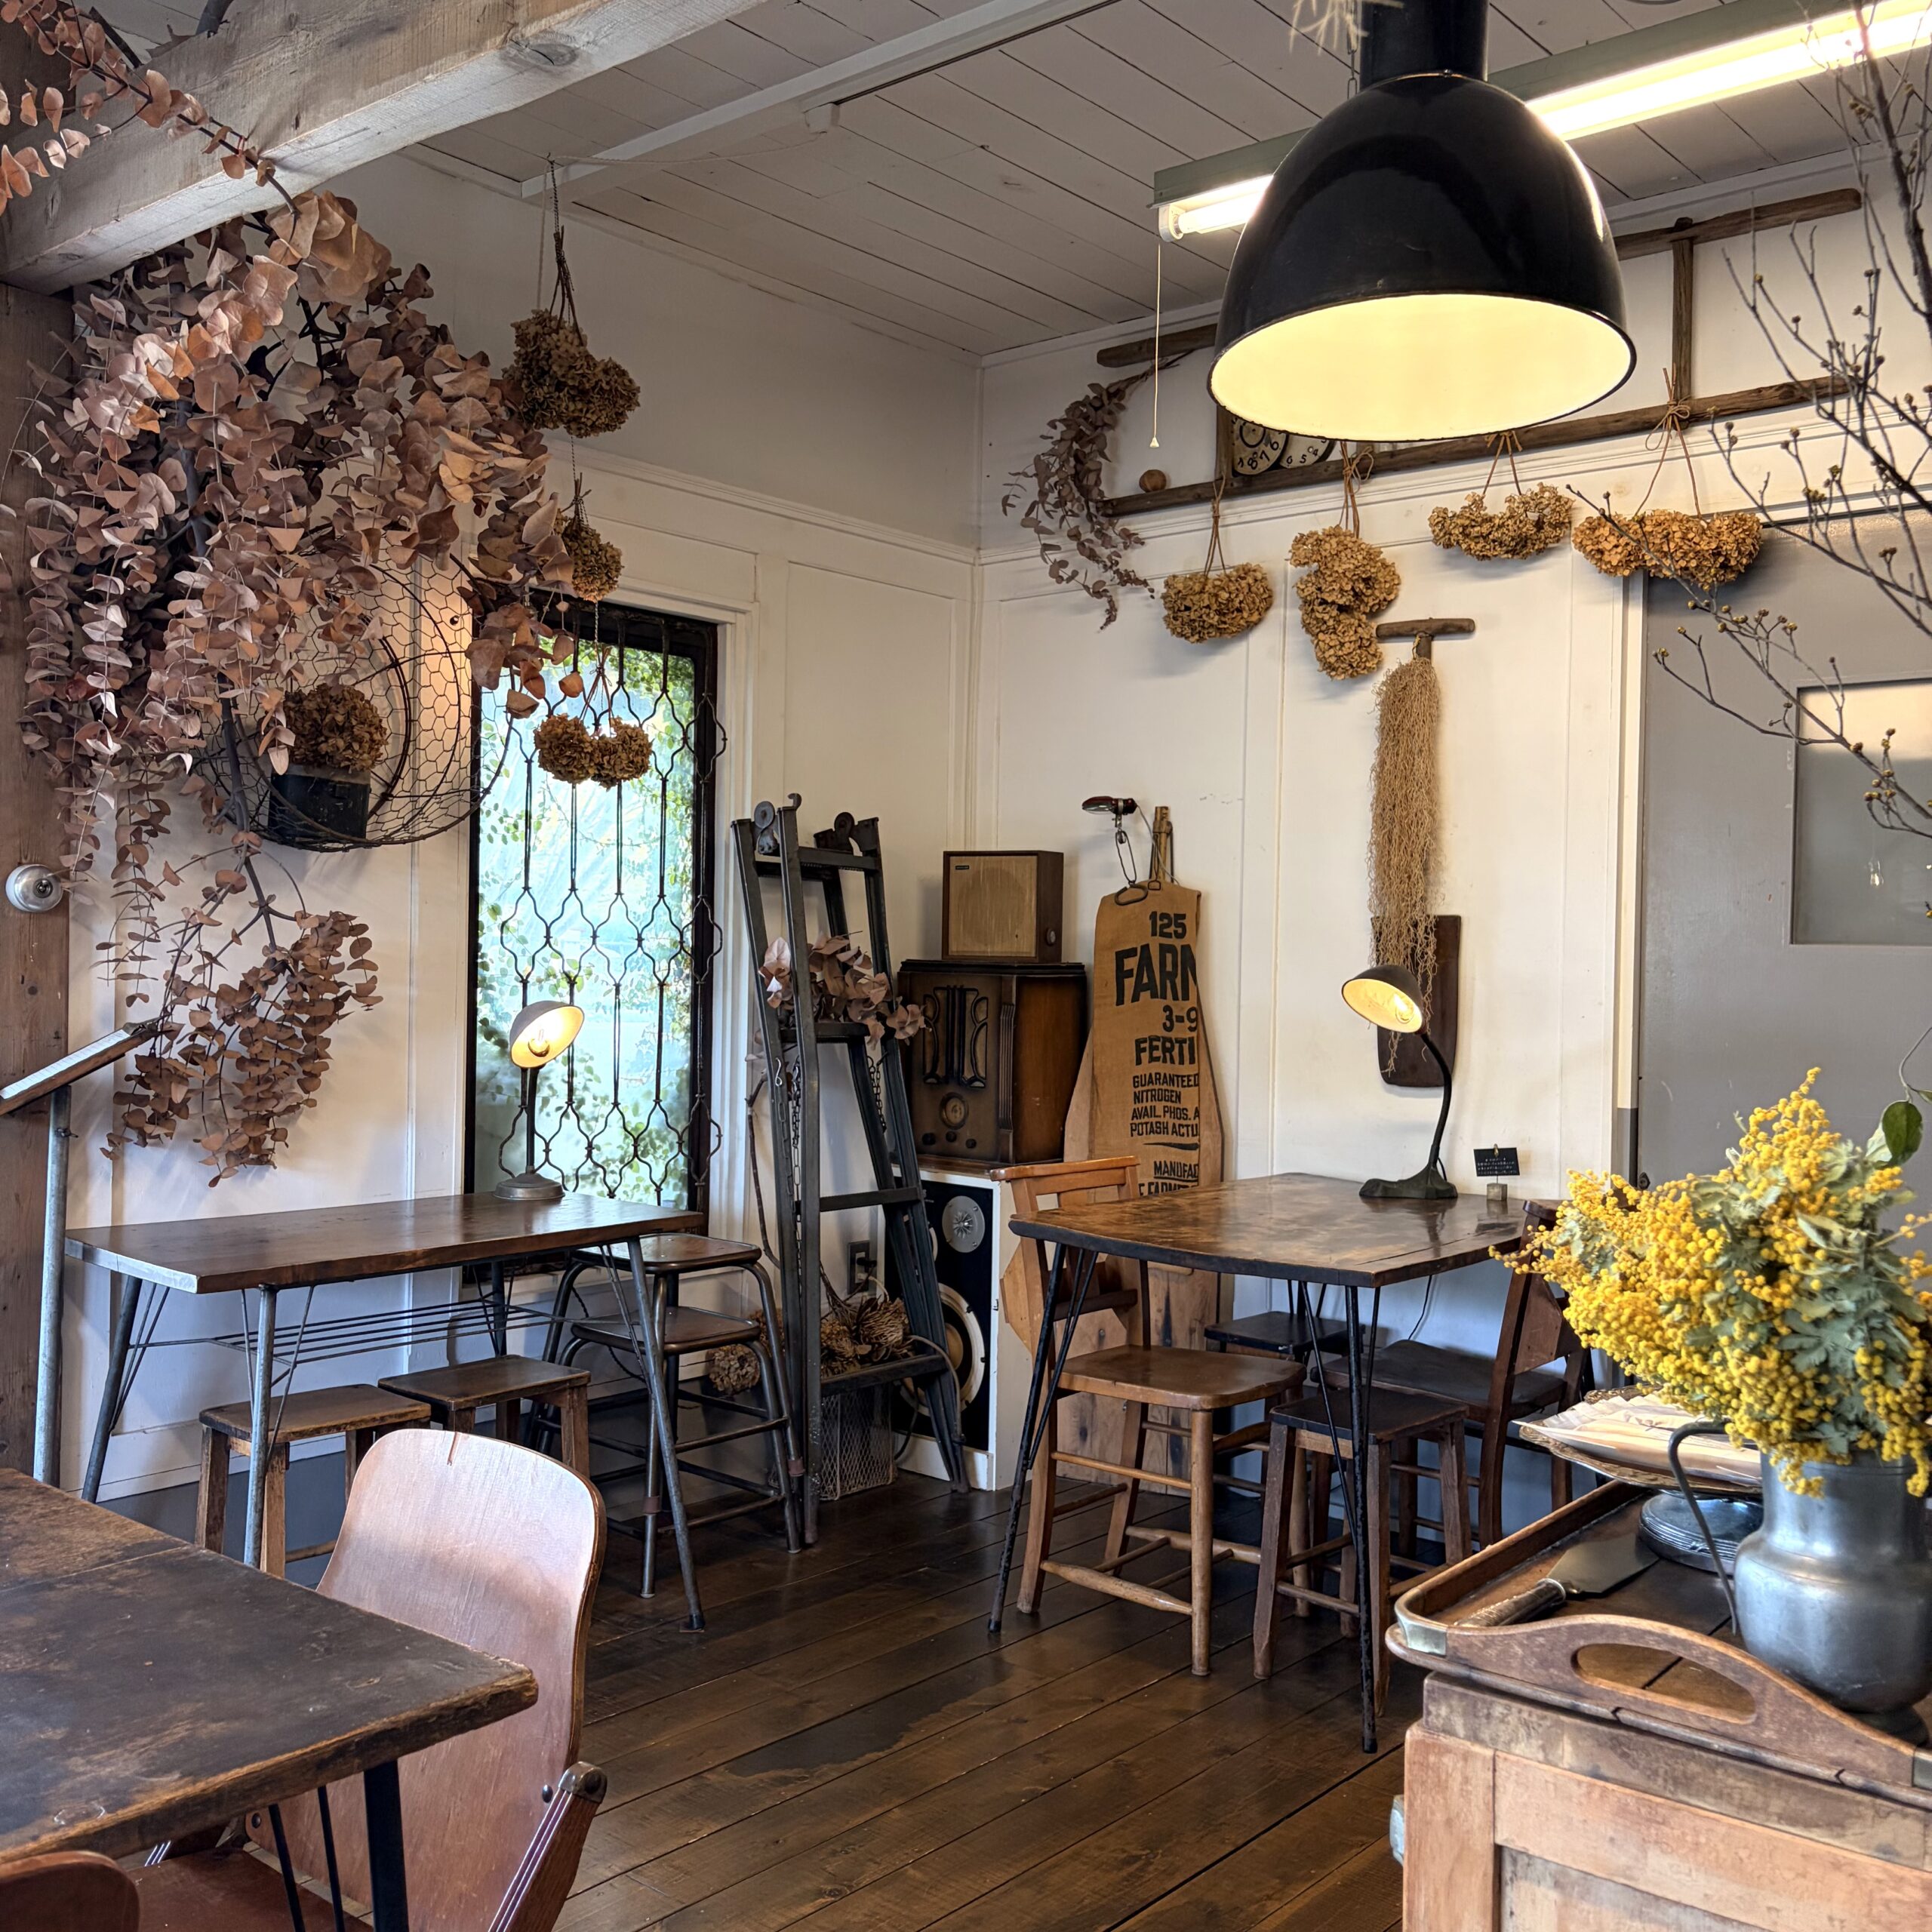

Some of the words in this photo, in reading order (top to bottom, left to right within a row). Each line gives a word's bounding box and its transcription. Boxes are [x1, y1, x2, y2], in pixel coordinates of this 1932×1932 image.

[1269, 440, 1279, 451] 6
[1312, 448, 1319, 457] 4
[1260, 450, 1270, 462] 7
[1286, 456, 1293, 464] 6
[1300, 454, 1307, 463] 5
[1149, 911, 1186, 939] 125
[1135, 1035, 1195, 1066] FERTI
[1133, 1072, 1198, 1088] GUARANTEED
[1134, 1088, 1181, 1104] NITROGEN
[1163, 1105, 1191, 1121] PHOS.
[1130, 1121, 1169, 1137] POTASH
[1171, 1122, 1198, 1137] ACTU
